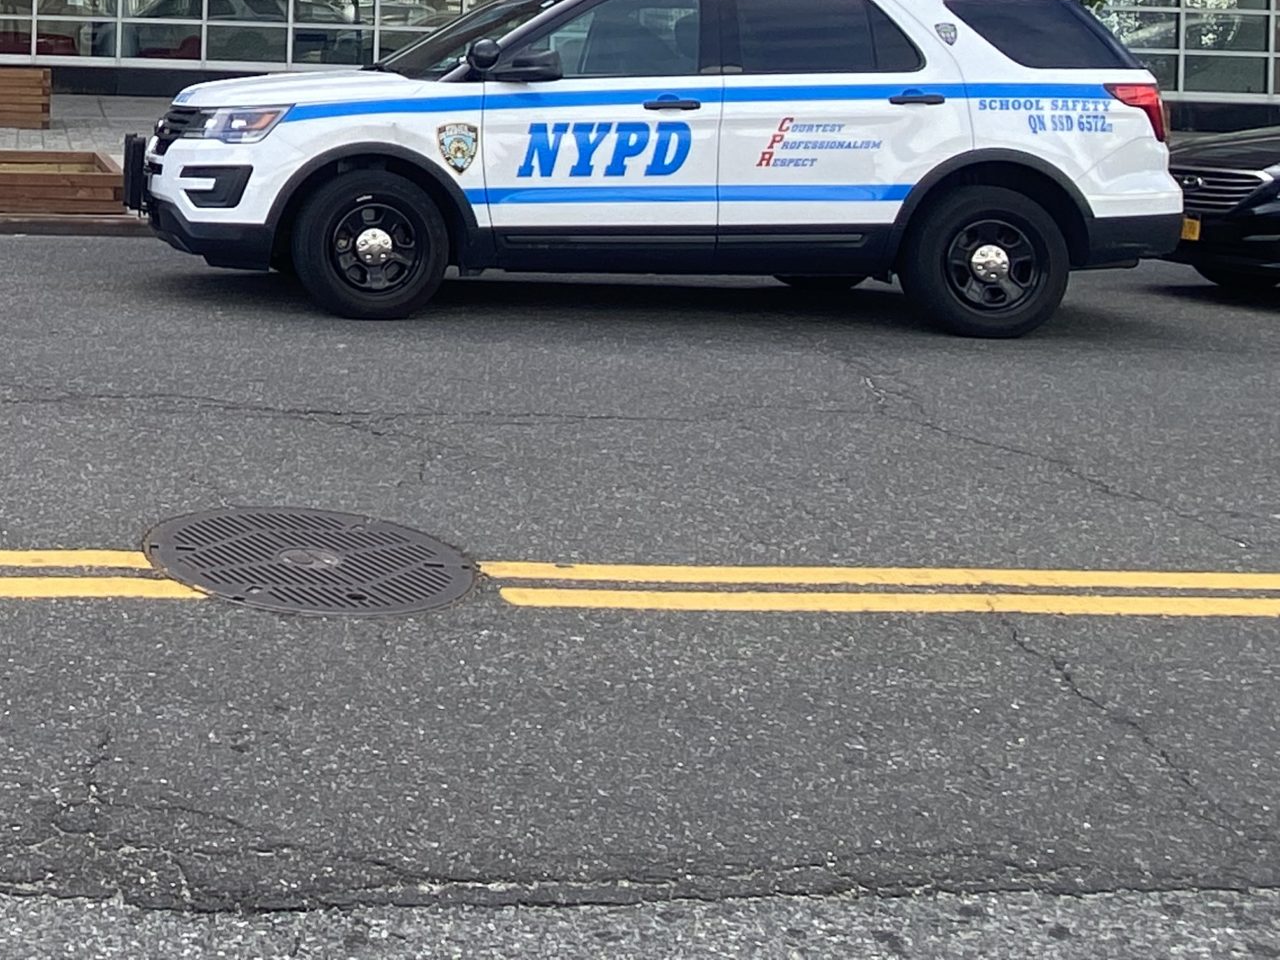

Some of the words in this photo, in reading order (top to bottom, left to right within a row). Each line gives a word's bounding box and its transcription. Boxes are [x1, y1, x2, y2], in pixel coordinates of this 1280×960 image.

[978, 99, 1044, 111] SCHOOL
[1050, 99, 1111, 111] SAFETY
[778, 116, 846, 133] COURTESY
[1028, 114, 1047, 134] QN
[1050, 114, 1074, 132] SSD
[516, 121, 692, 178] NYPD
[756, 151, 819, 167] RESPECT
